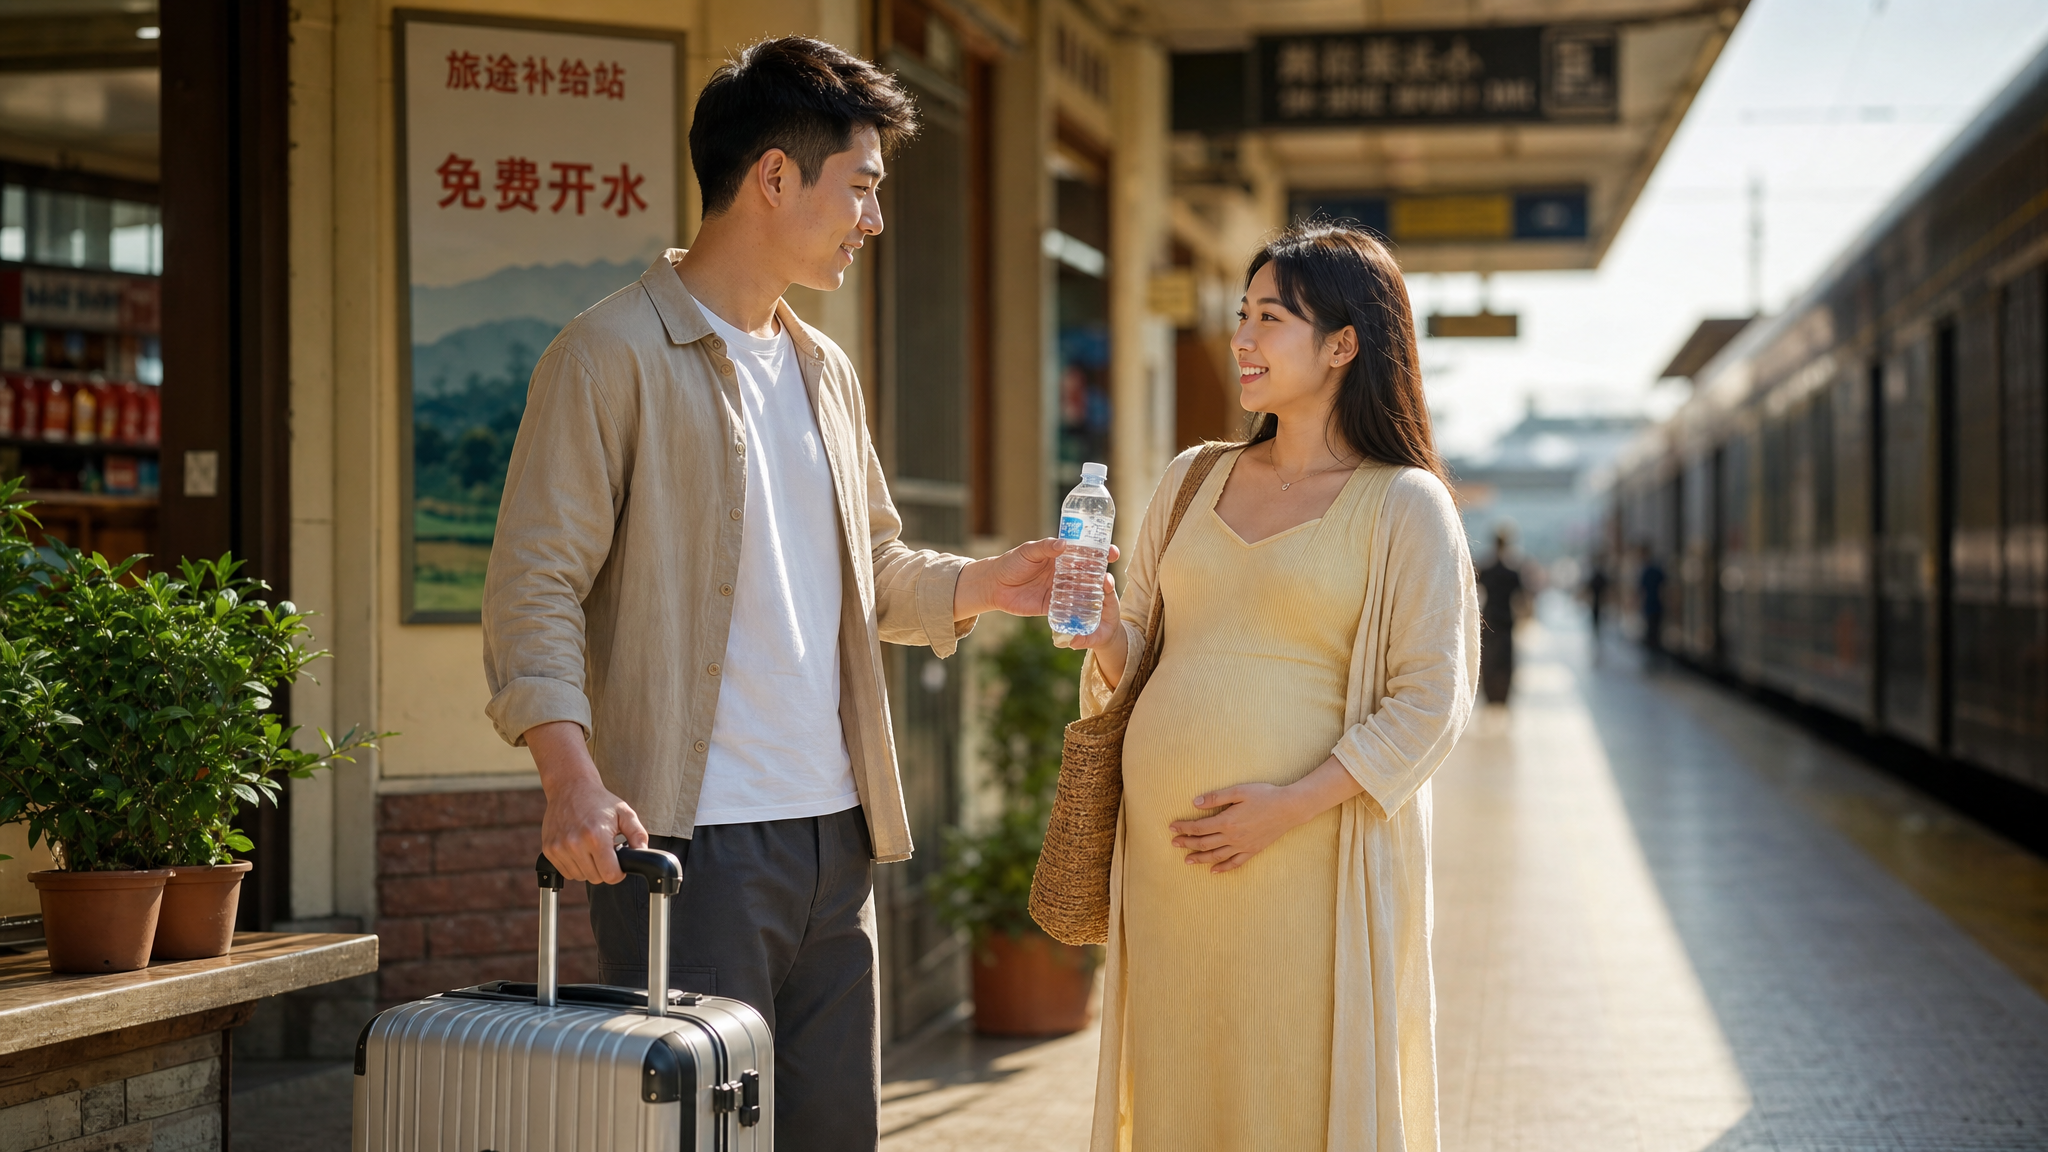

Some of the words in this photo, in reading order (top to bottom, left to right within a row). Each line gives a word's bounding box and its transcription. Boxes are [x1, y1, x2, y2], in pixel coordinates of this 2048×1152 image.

[445, 49, 626, 100] 旅途补给站
[436, 153, 648, 217] 免费开水
